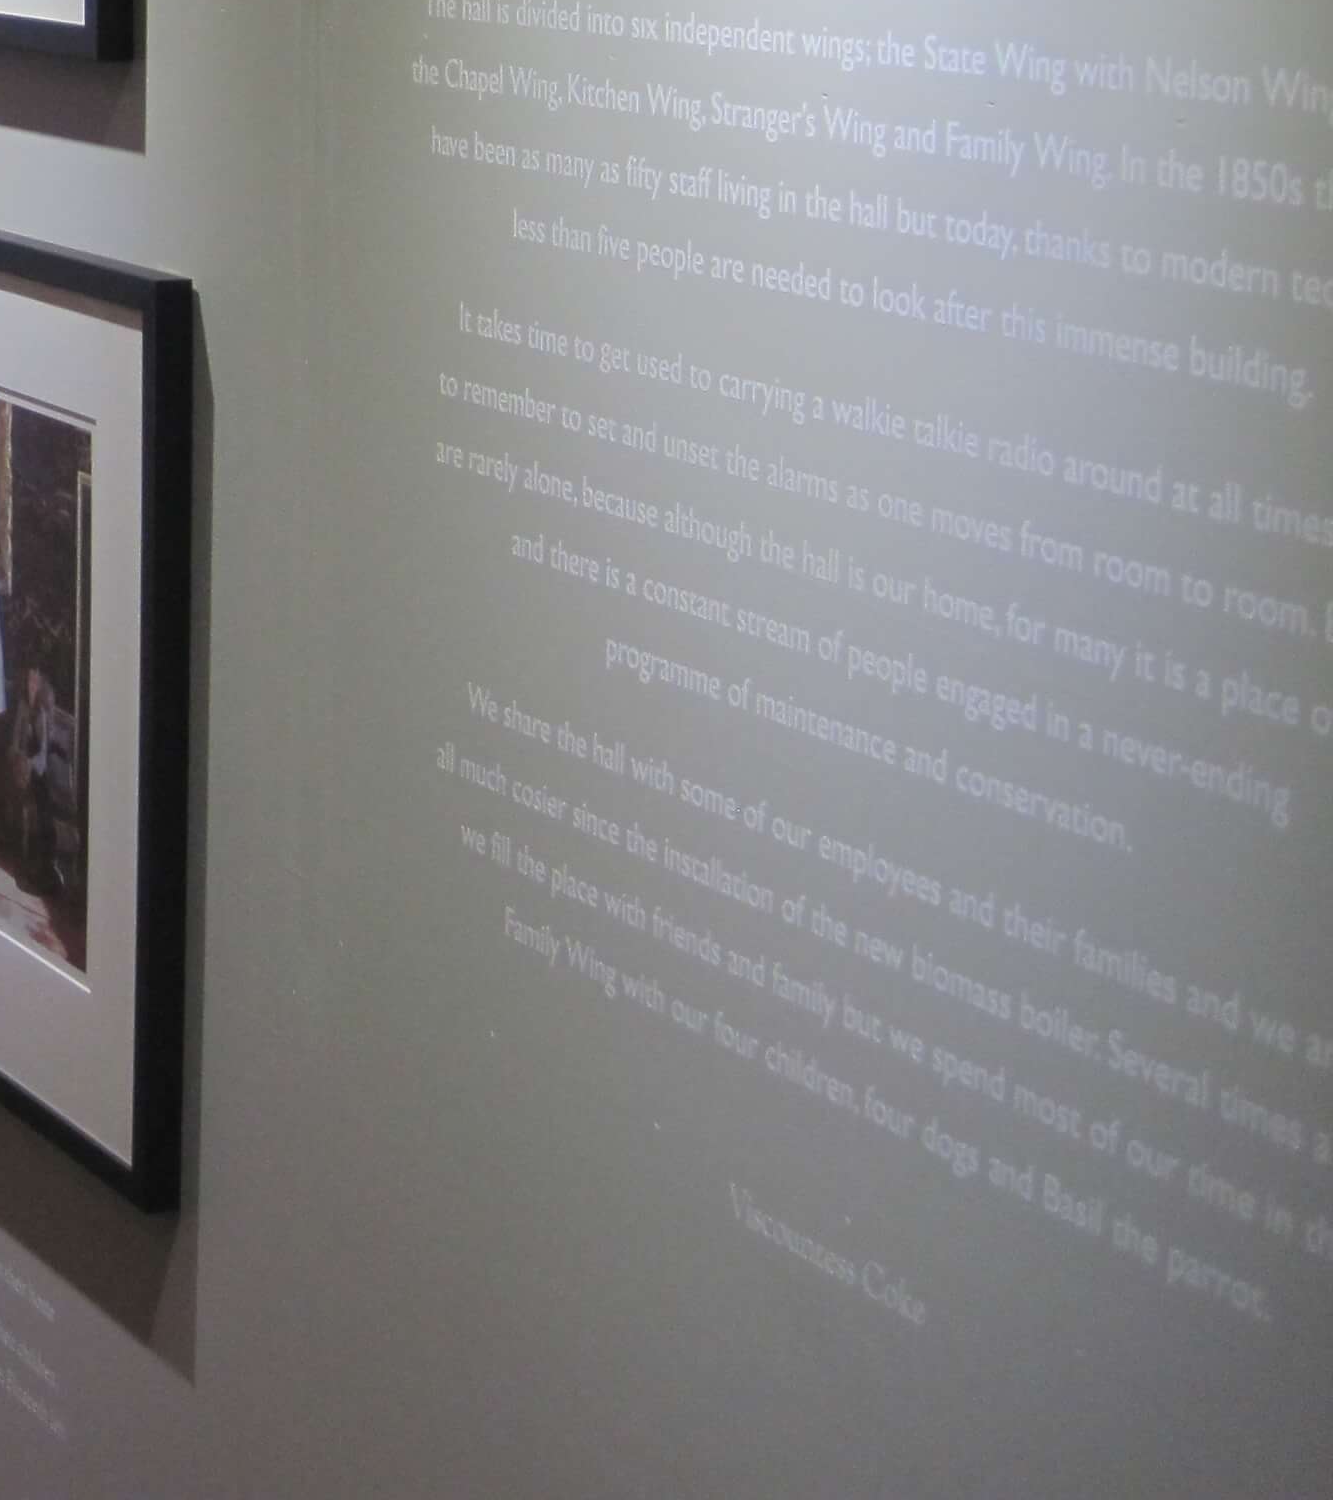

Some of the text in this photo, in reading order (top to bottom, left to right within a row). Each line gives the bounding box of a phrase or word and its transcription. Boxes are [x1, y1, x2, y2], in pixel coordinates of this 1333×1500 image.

[412, 55, 439, 85] the
[445, 58, 503, 100] Chapel
[568, 73, 639, 113] Kitchen
[712, 92, 816, 142] Stranger's
[824, 105, 886, 158] Wing
[894, 120, 936, 154] and
[947, 121, 1024, 177] Family
[1122, 144, 1145, 183] In
[1157, 149, 1203, 192] the
[1219, 157, 1303, 206] 1850s
[588, 5, 624, 36] into
[632, 17, 658, 40] six
[665, 12, 794, 56] independent
[878, 31, 915, 67] the
[924, 34, 985, 75] State
[995, 42, 1066, 96] Wing
[1075, 53, 1133, 90] with
[1147, 57, 1250, 104] Nelson
[1262, 66, 1333, 124] Win
[431, 126, 468, 158] have
[474, 131, 515, 166] been
[522, 149, 540, 170] as
[546, 153, 594, 188] many
[601, 162, 619, 183] as
[626, 155, 662, 200] fifty
[669, 166, 712, 198] staff
[718, 169, 771, 219] living
[779, 181, 796, 213] in
[806, 184, 841, 221] the
[850, 190, 887, 229] hall
[897, 198, 937, 238] but
[1025, 220, 1110, 268] thanks
[1121, 245, 1151, 275] to
[1163, 249, 1279, 296] modern
[513, 208, 545, 243] less
[552, 216, 591, 252] than
[598, 225, 629, 259] five
[637, 240, 704, 280] people
[711, 256, 744, 283] are
[752, 262, 831, 300] needed
[840, 280, 864, 307] to
[873, 276, 925, 320] look
[934, 290, 992, 331] after
[1002, 303, 1045, 343] this
[1057, 314, 1179, 371] immense
[460, 301, 472, 332] It
[477, 309, 521, 344] takes
[528, 321, 568, 356] time
[574, 336, 594, 362] to
[599, 343, 630, 373] get
[637, 353, 682, 384] used
[690, 365, 711, 390] to
[719, 374, 805, 425] carrying
[813, 396, 823, 420] a
[832, 397, 905, 439] walkie
[915, 414, 978, 457] talkie
[988, 434, 1055, 476] radio
[1064, 456, 1162, 504] around
[1172, 482, 1199, 513] at
[1209, 482, 1241, 522] all
[512, 534, 1290, 828] and there is a constant stream of people engaged in a never-ending
[606, 639, 720, 700] programme
[728, 678, 751, 709] of
[756, 693, 896, 764] maintenance
[905, 747, 947, 784] and
